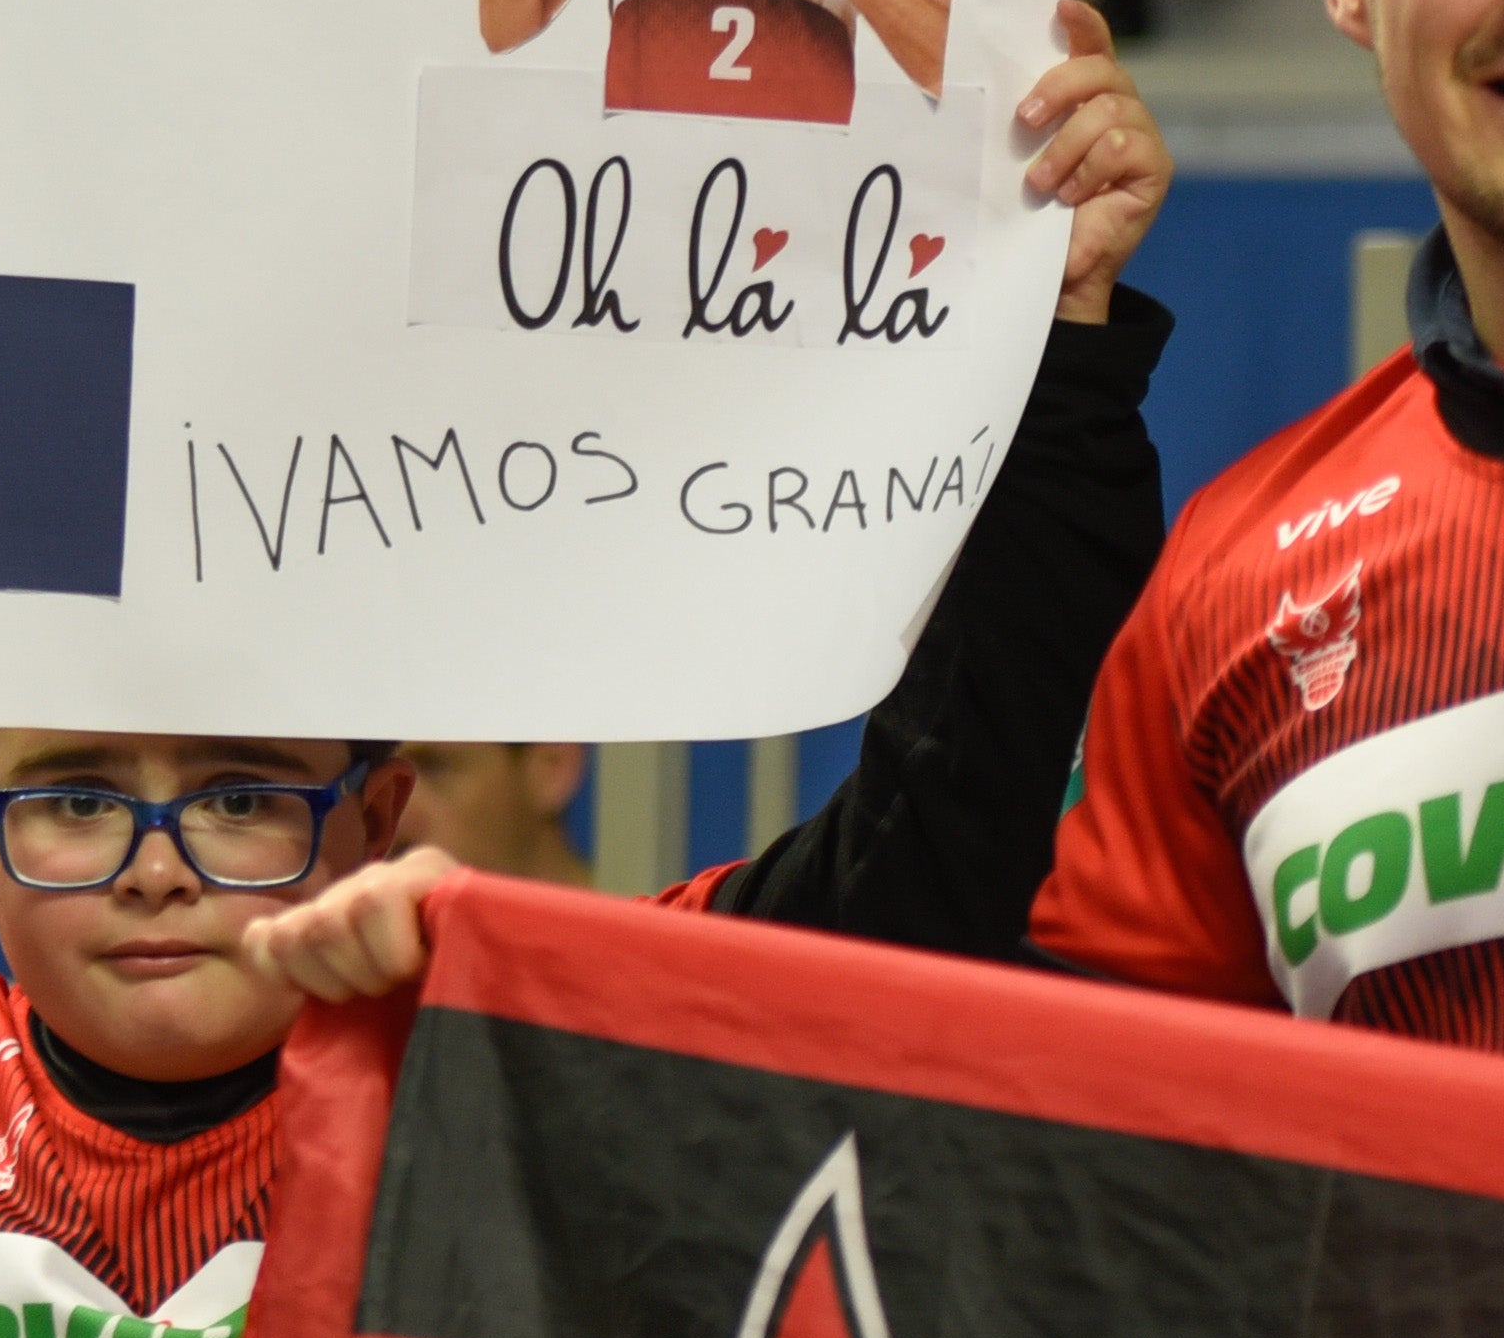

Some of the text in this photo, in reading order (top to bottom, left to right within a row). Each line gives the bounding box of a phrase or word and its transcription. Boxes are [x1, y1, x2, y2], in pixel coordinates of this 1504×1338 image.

[708, 6, 756, 82] 2
[497, 155, 640, 333] Oh
[184, 422, 639, 582] ¡VAMOS
[1276, 474, 1402, 551] vive
